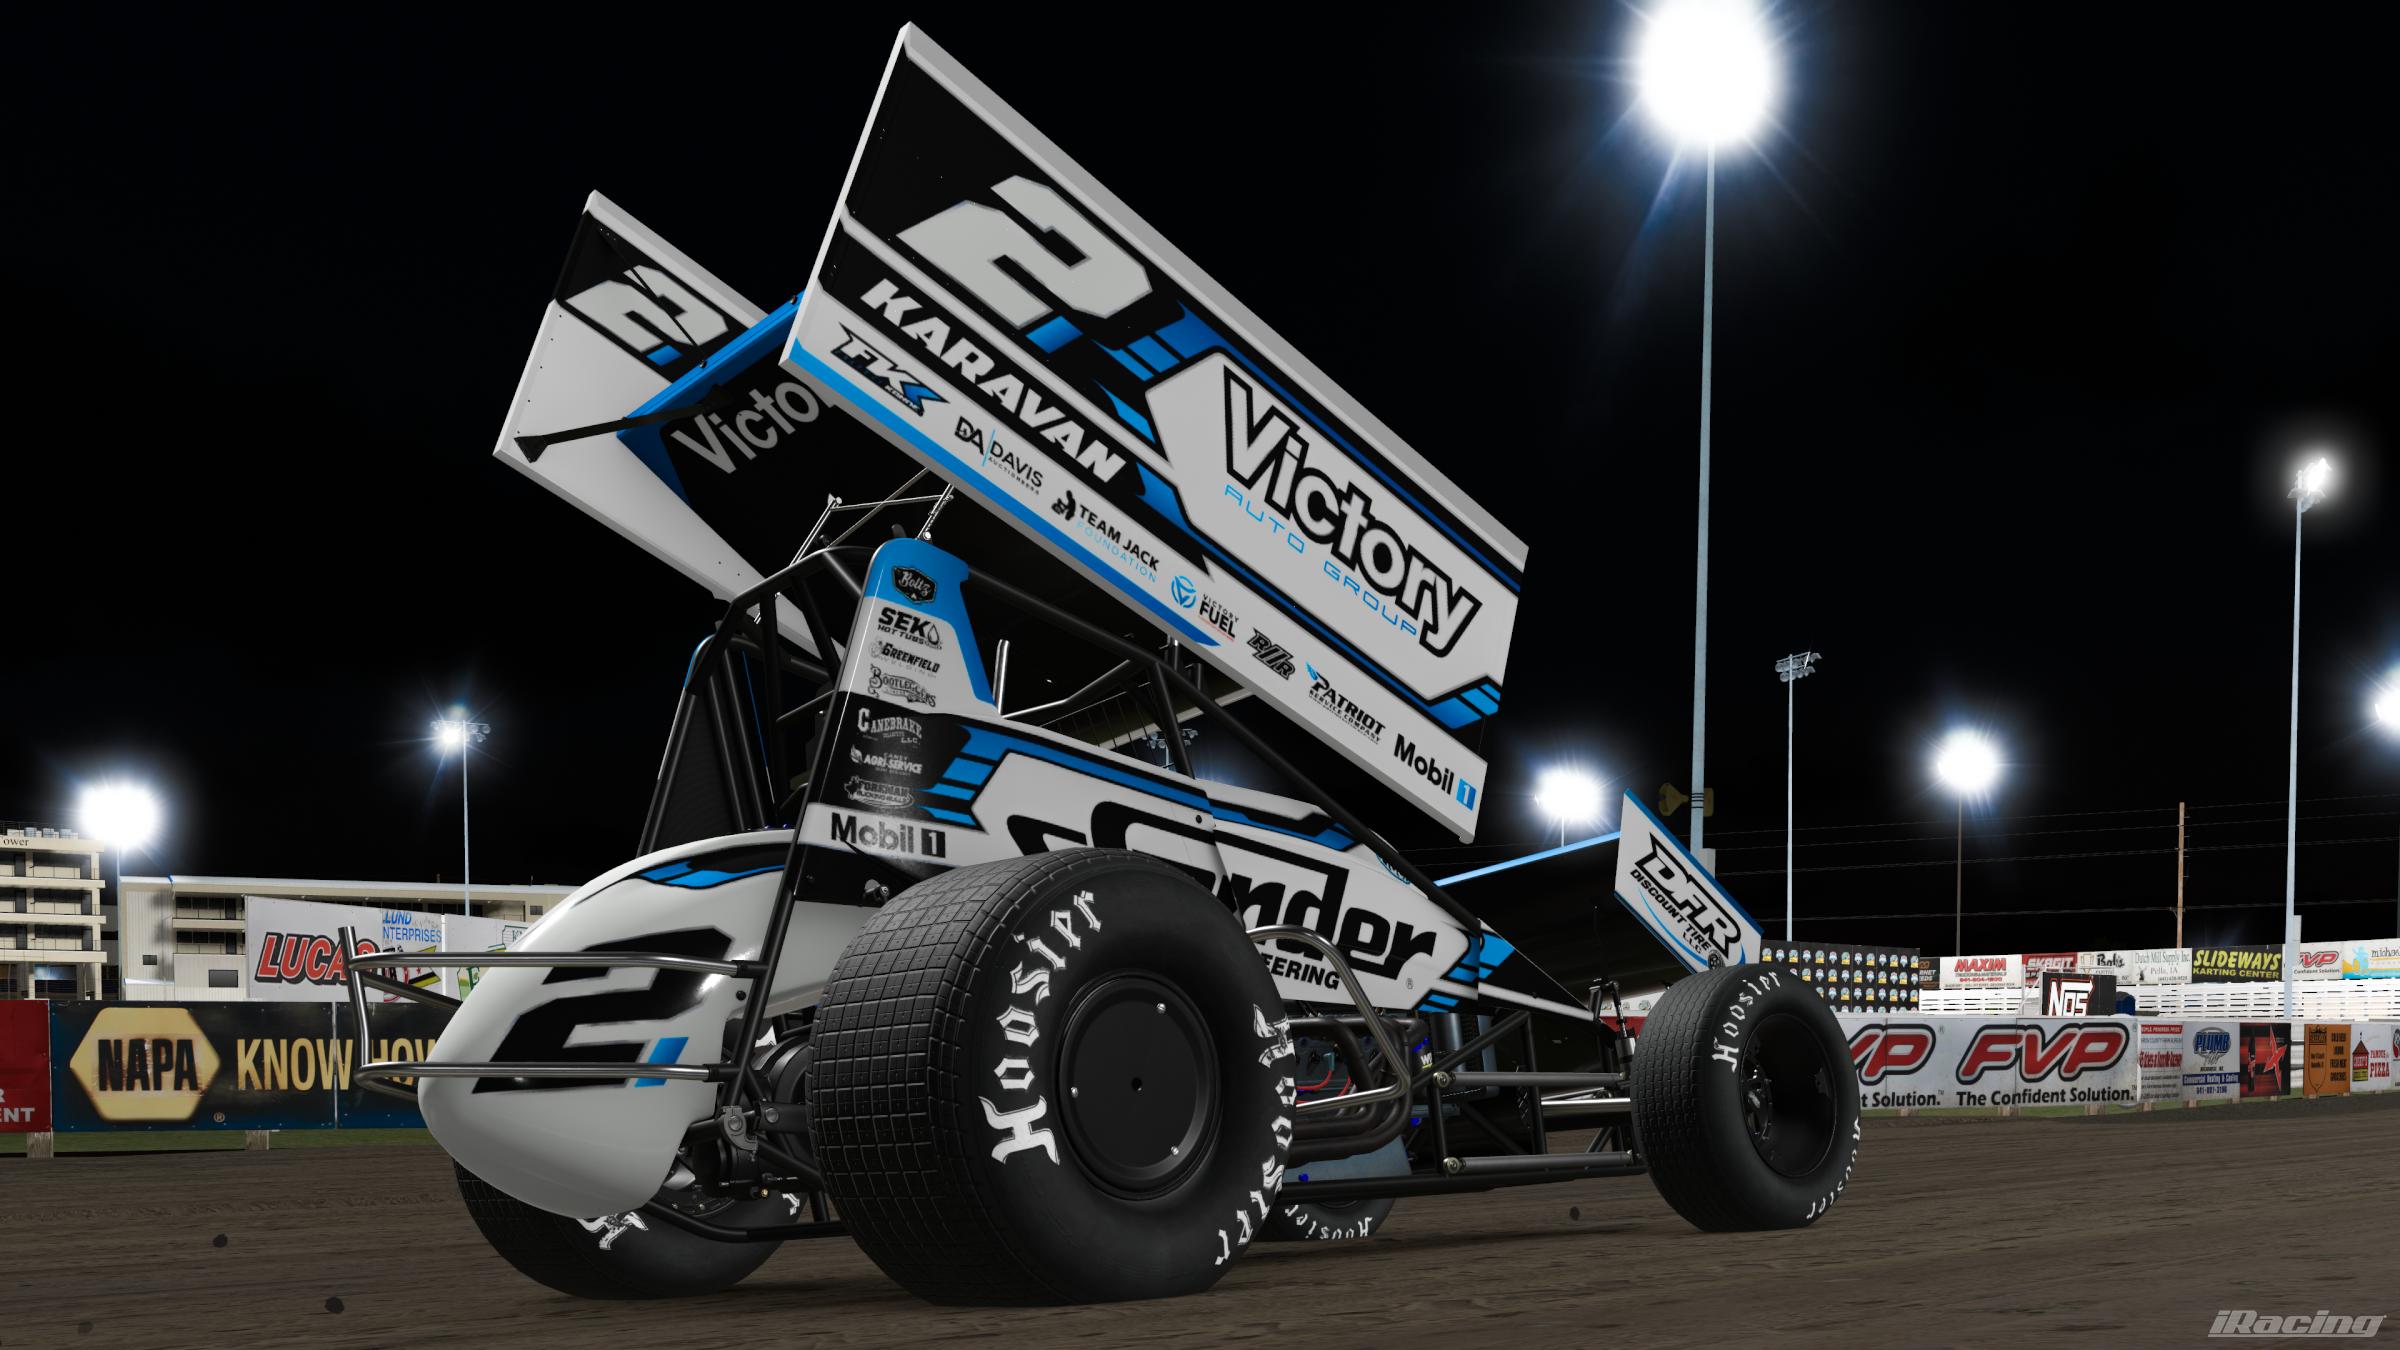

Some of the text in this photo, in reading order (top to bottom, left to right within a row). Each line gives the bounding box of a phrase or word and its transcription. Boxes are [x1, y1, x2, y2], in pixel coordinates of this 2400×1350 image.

[896, 174, 1153, 331] 2
[564, 264, 730, 353] 2
[860, 278, 1127, 483] KARAVAN
[670, 381, 834, 475] Victo
[990, 440, 1044, 488] DAVIS
[1079, 503, 1160, 572] TEAM JACK
[1223, 364, 1483, 658] Victory
[1075, 520, 1157, 583] FOUNDATION
[1223, 484, 1418, 637] AUTO GROUP
[877, 624, 898, 636] HOT
[878, 606, 931, 638] SEK
[1199, 599, 1236, 639] FUEL
[1203, 593, 1239, 623] VICTORY
[881, 642, 941, 673] GREENFIELD
[857, 707, 923, 740] CANEBRAKE
[1311, 671, 1387, 736] PATRIOT
[863, 753, 923, 775] AGRI-SERVICE
[1394, 733, 1455, 796] Mobil
[831, 812, 914, 854] Mobil
[383, 910, 412, 925] LUND
[1630, 868, 1712, 951] DISCOUNT TIRE
[1954, 957, 2007, 973] MAXIM
[2193, 949, 2282, 971] SLIDEWAYS
[2193, 967, 2280, 979] KARTING CENTER
[471, 925, 736, 1095] 2
[1712, 969, 1781, 1074] Hoosier
[2047, 979, 2094, 1016] NOS
[978, 890, 1102, 1166] Hoosier
[1955, 1022, 2131, 1086] FVP
[97, 1038, 199, 1092] NAPA
[237, 1038, 354, 1091] KNOW
[1872, 1091, 1941, 1108] Solution.
[1956, 1090, 1987, 1107] The
[1992, 1088, 2066, 1106] Confident
[2069, 1086, 2135, 1103] Solution.
